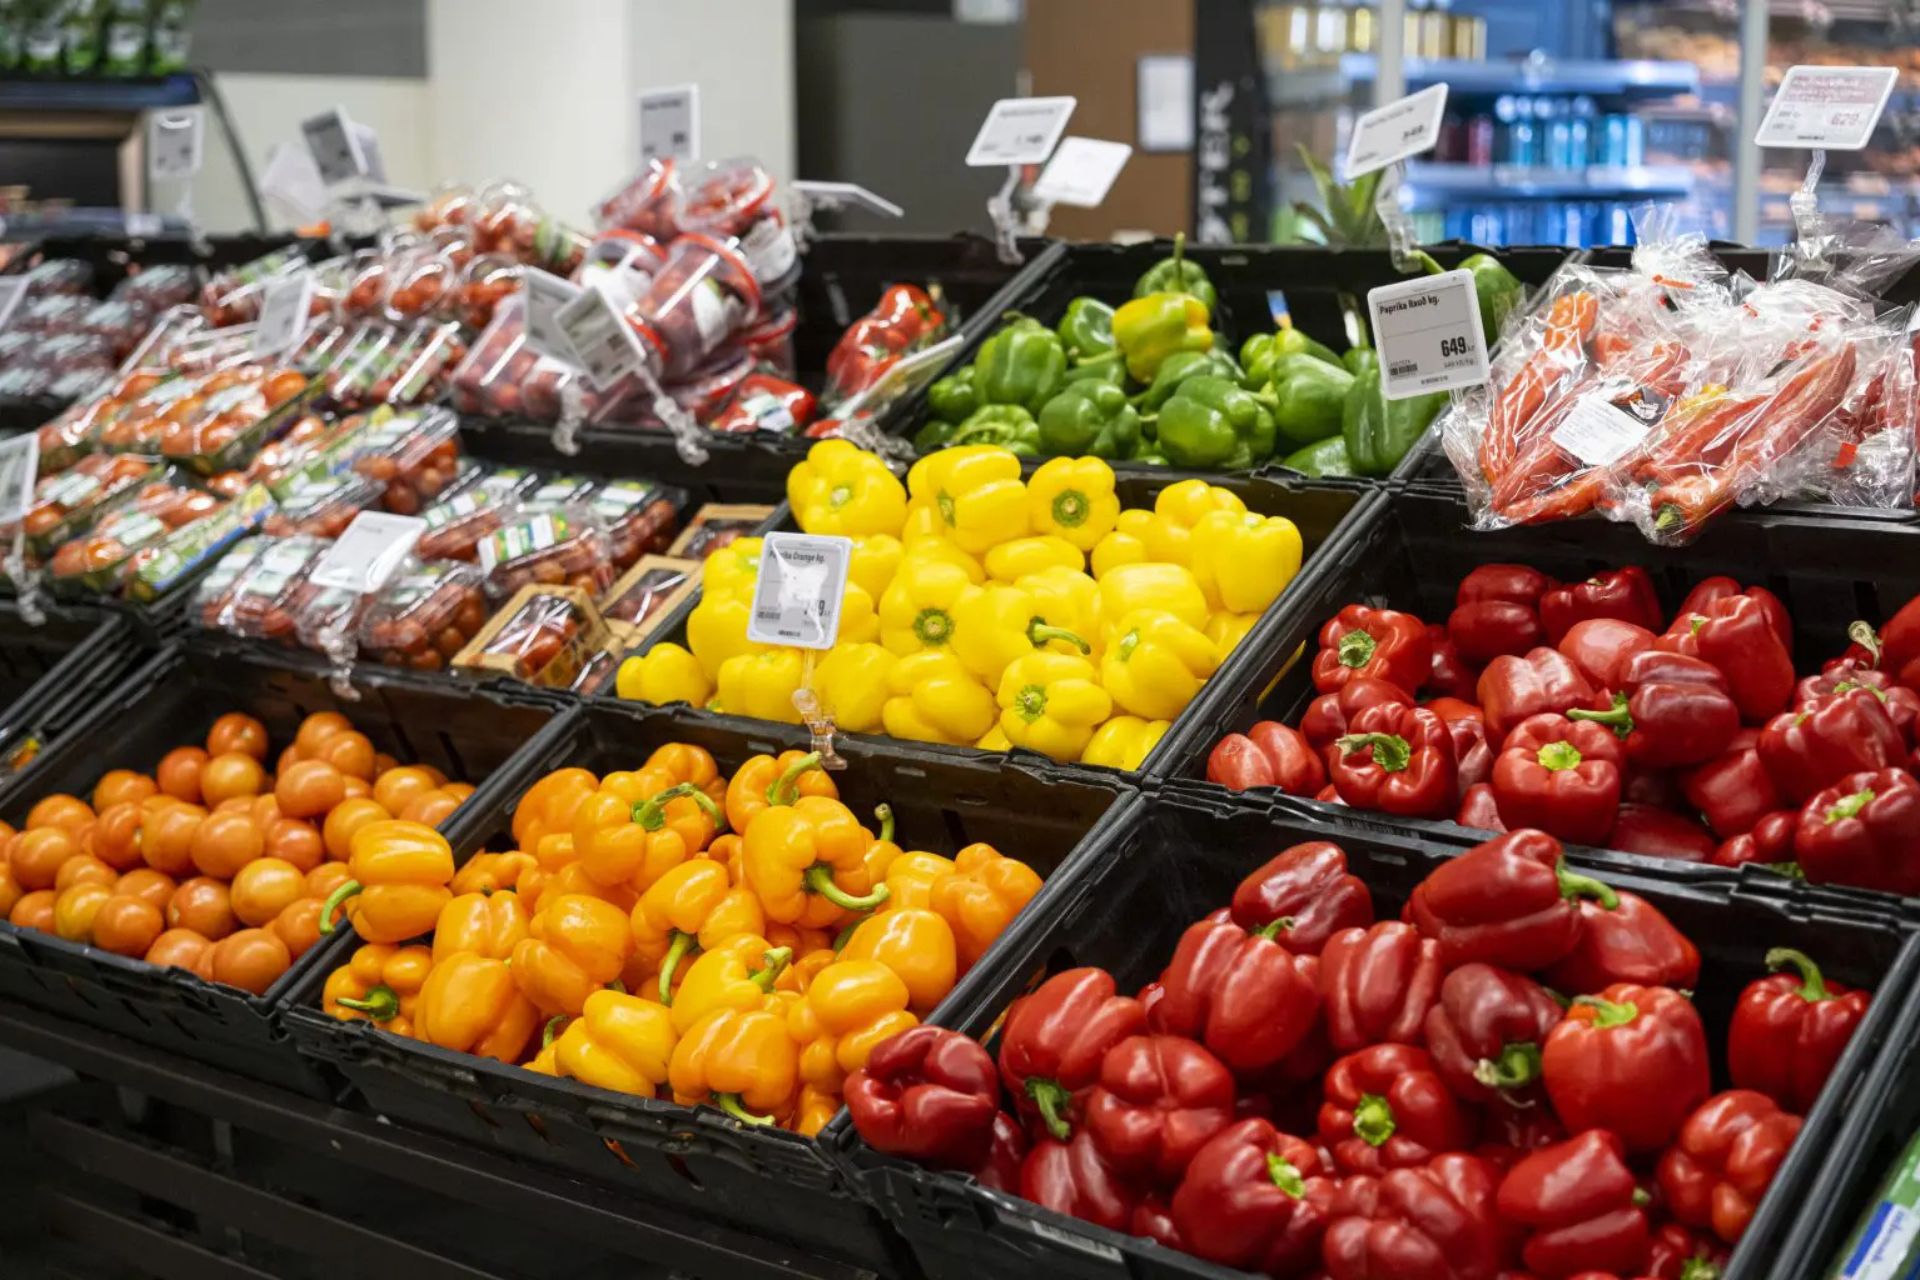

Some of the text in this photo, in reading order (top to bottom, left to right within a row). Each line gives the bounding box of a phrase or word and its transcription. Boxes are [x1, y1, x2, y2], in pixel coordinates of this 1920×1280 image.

[1379, 295, 1440, 315] Paprika Rauð kg.
[1441, 336, 1467, 357] 649
